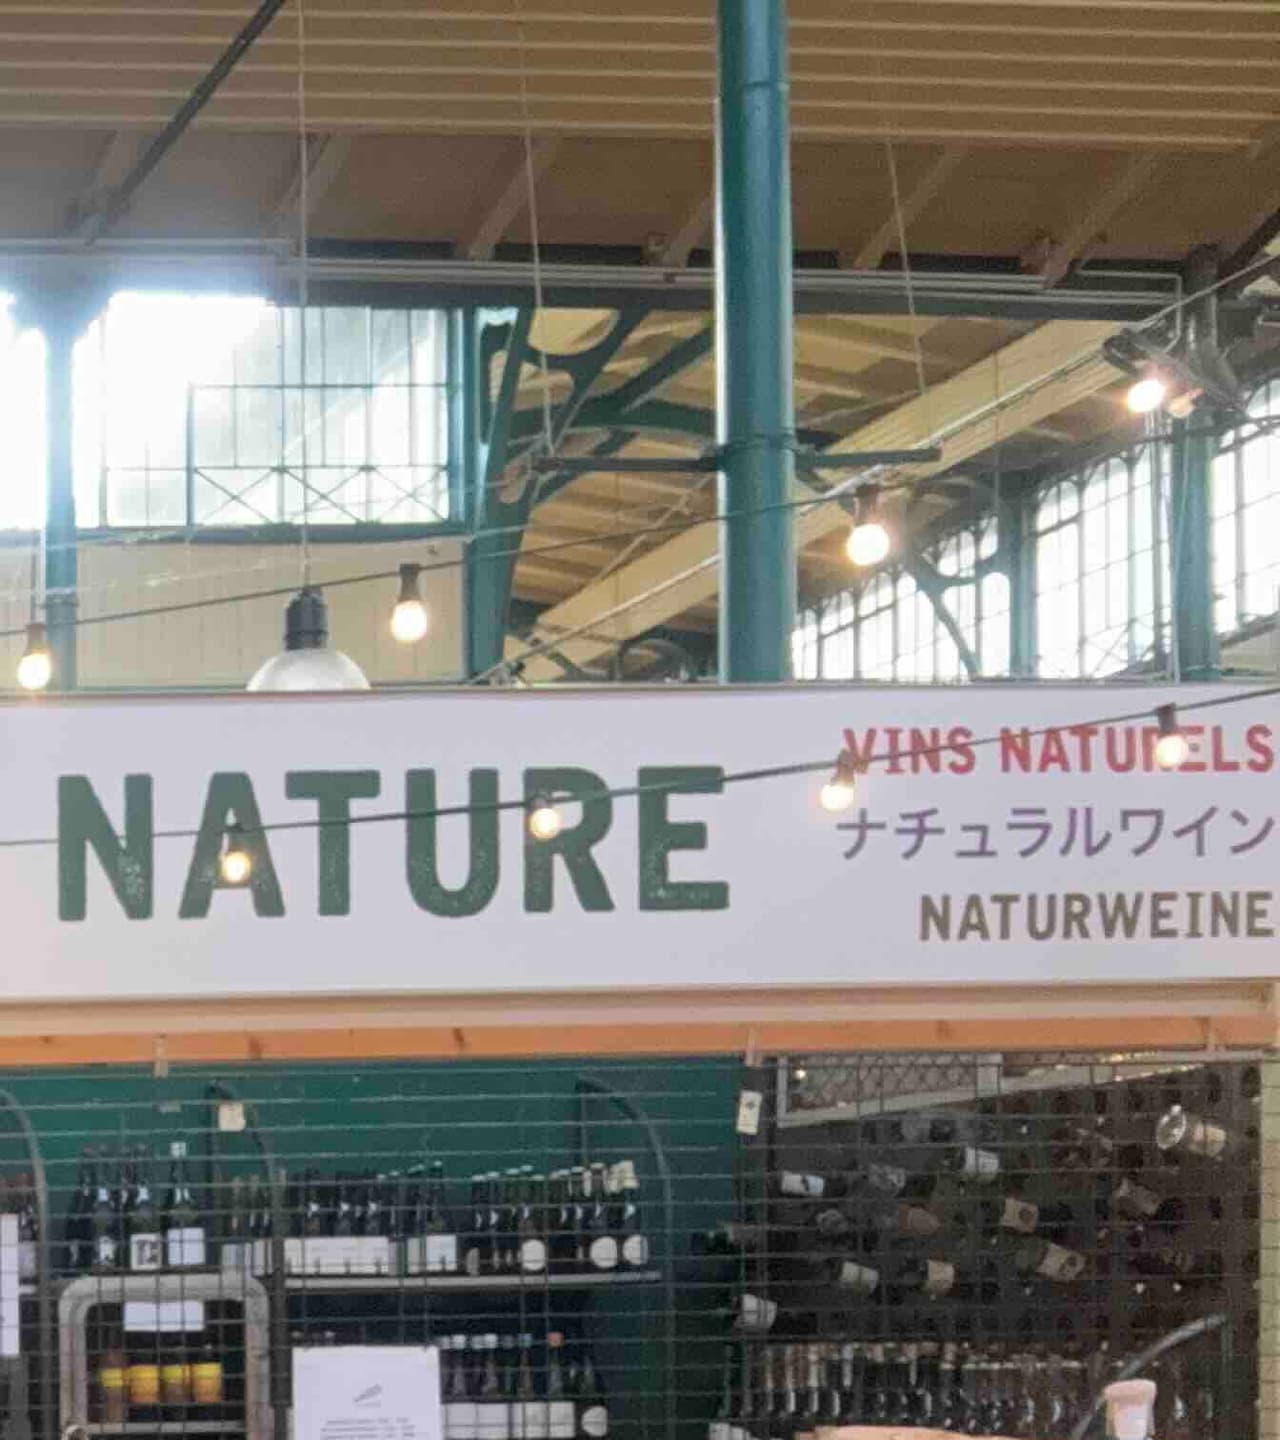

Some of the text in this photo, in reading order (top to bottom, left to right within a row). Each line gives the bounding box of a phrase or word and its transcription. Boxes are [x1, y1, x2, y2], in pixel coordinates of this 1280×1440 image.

[842, 727, 977, 775] VINS
[58, 765, 731, 920] NATURE
[835, 805, 1276, 861] ナチュラルワイン
[919, 890, 1276, 942] NATURWEINE
